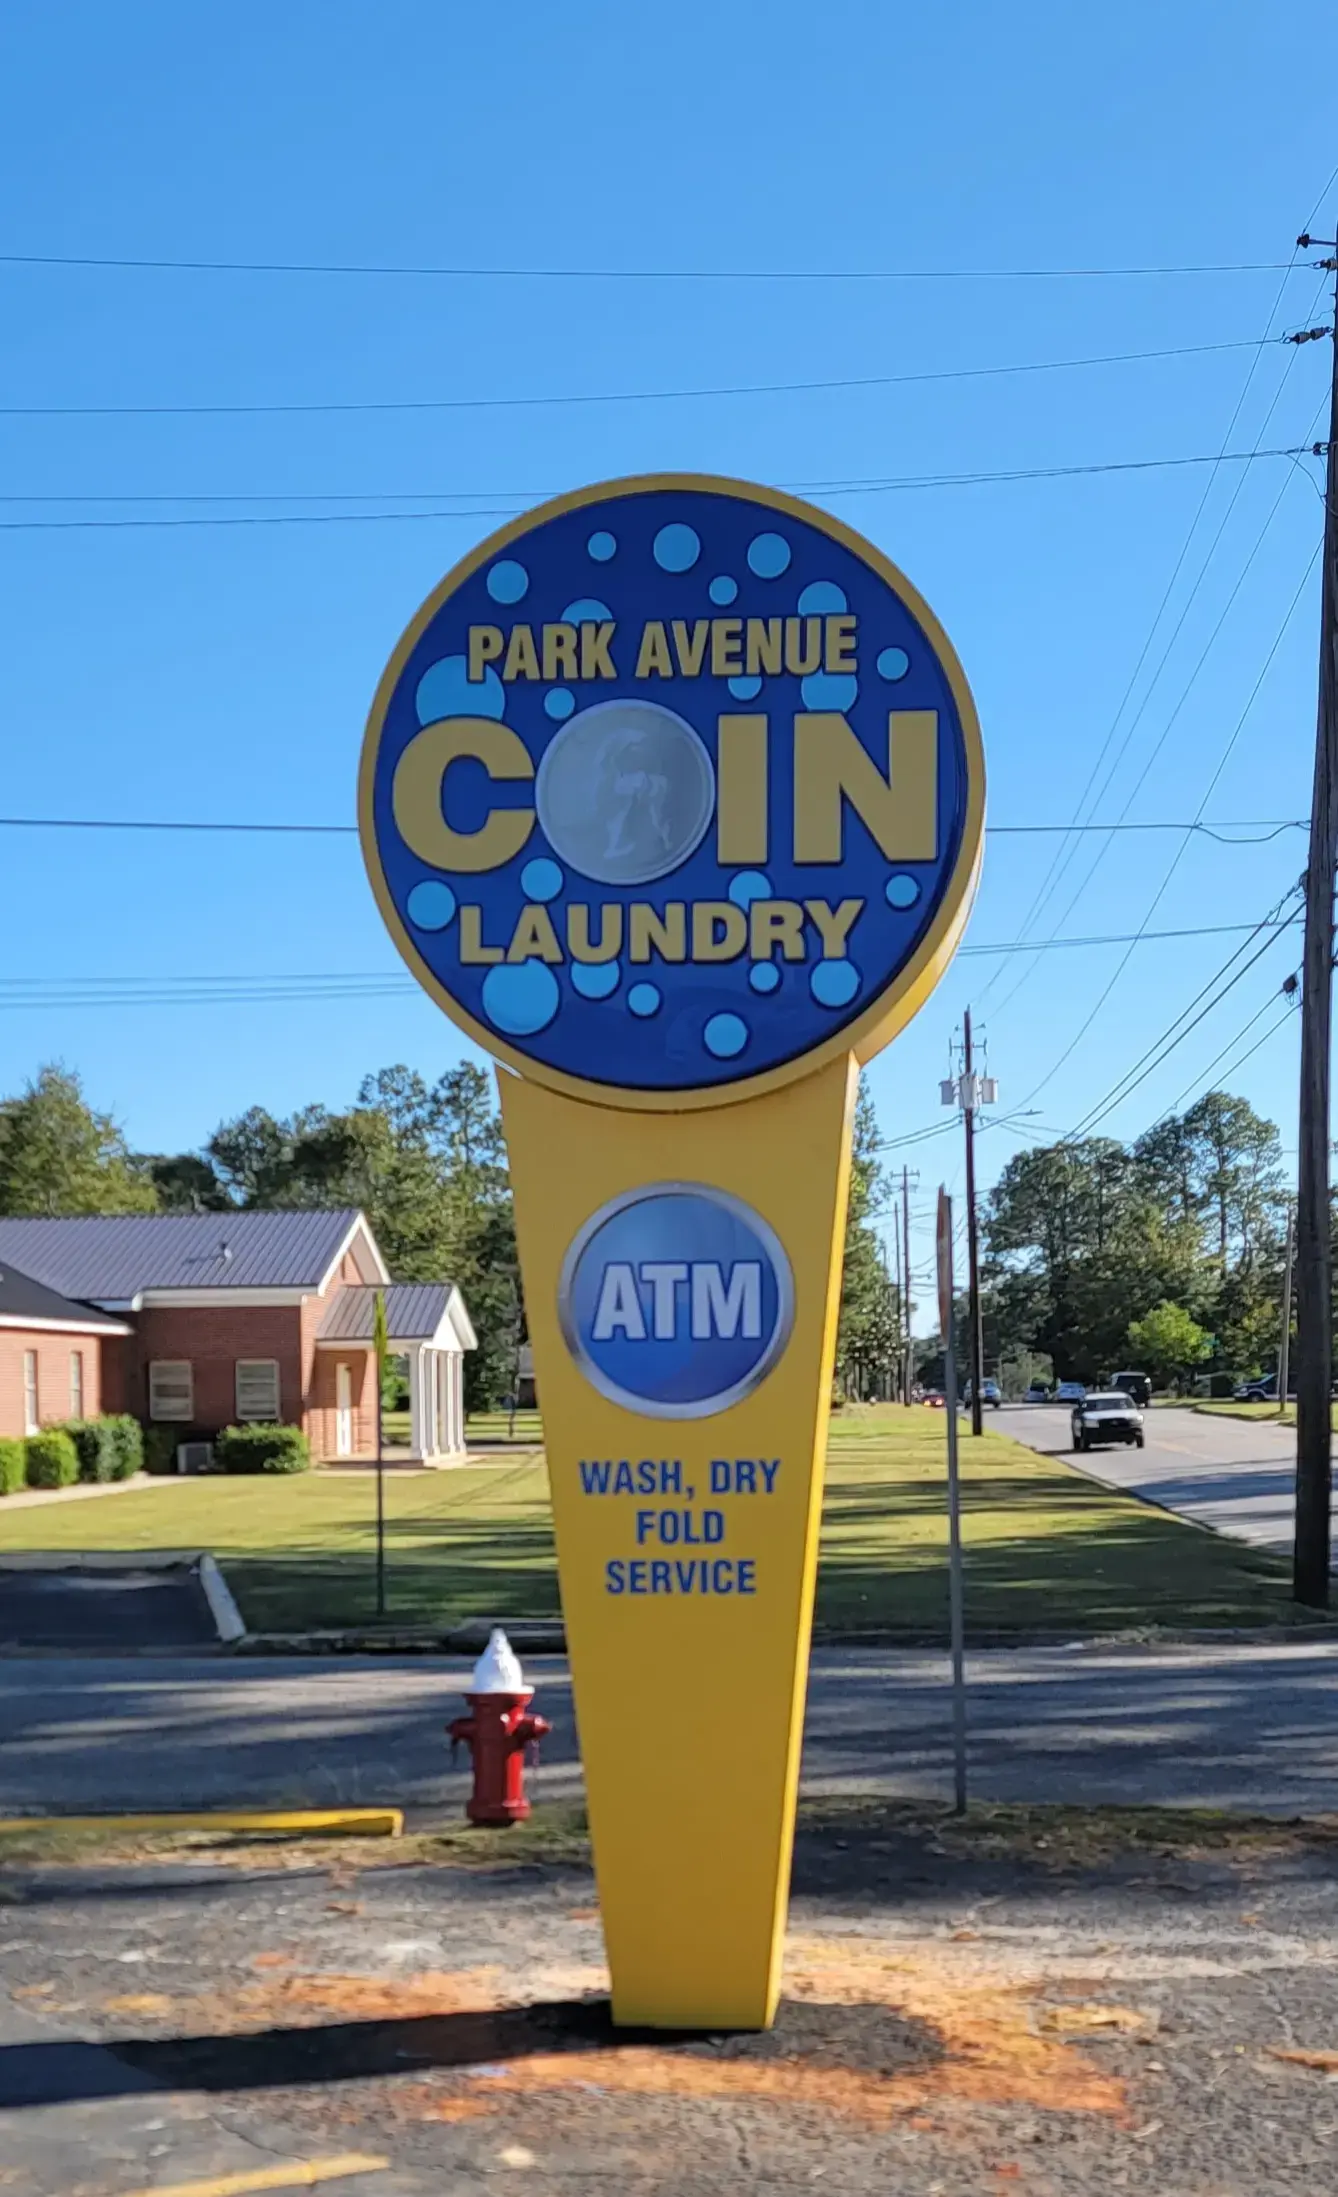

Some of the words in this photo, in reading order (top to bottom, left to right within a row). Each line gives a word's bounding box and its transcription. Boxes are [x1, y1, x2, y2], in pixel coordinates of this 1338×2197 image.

[467, 620, 617, 682] PARK
[635, 614, 858, 680] AVENUE
[459, 900, 864, 965] LAUNDRY
[593, 1262, 762, 1341] ATM
[579, 1460, 695, 1501] WASH,
[710, 1459, 781, 1494] DRY
[636, 1511, 724, 1543] FOLD
[606, 1560, 757, 1594] SERVICE
